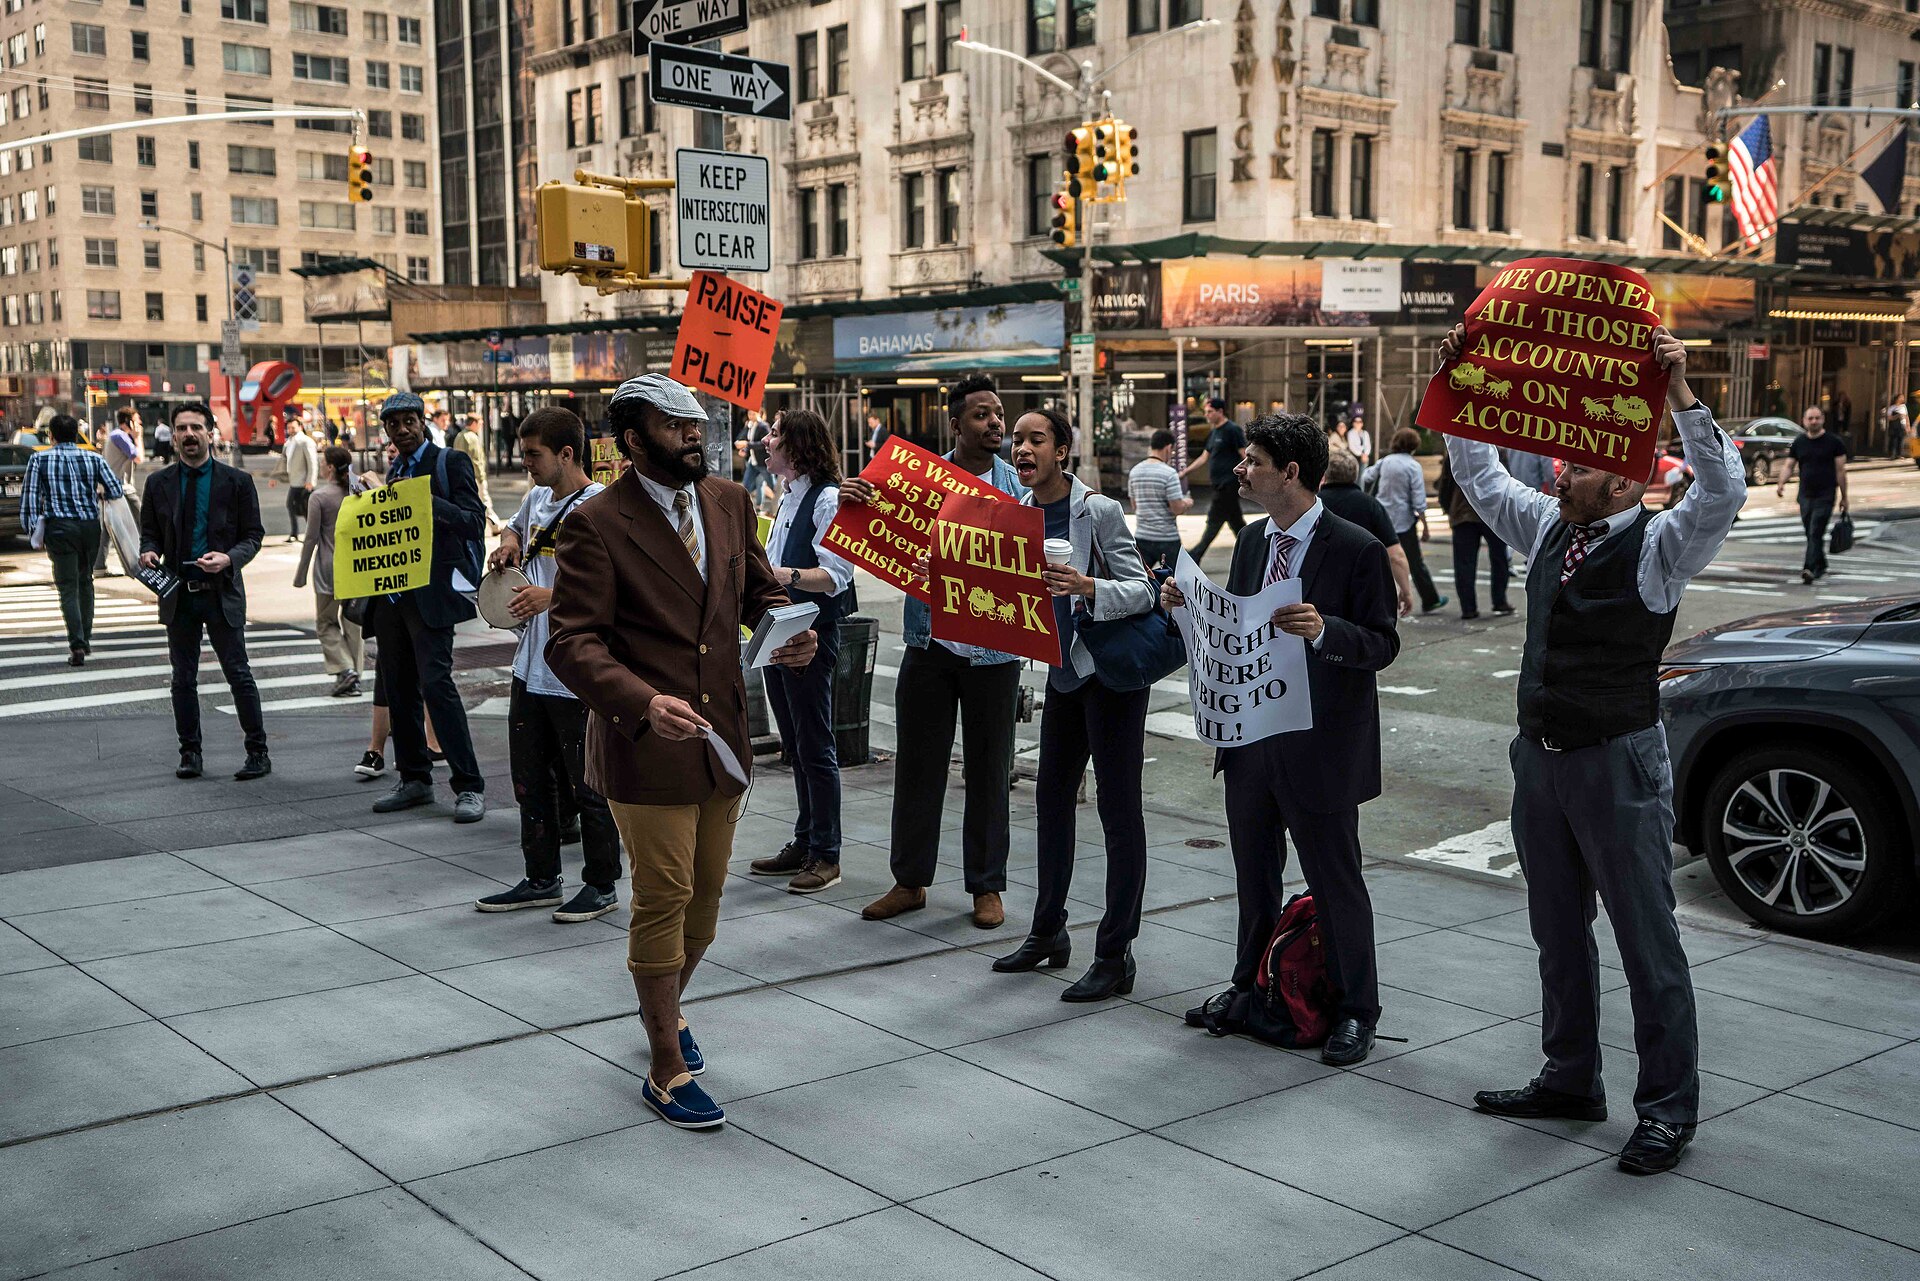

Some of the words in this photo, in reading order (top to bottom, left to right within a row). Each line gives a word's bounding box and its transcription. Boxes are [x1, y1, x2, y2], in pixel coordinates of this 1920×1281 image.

[651, 8, 682, 35] ONE
[697, 0, 729, 23] WAY
[672, 65, 712, 92] ONE
[730, 75, 770, 100] WAY
[700, 163, 747, 191] KEEP
[681, 198, 766, 225] INTERSECTION
[695, 232, 755, 259] CLEAR
[1199, 283, 1260, 304] PARIS
[1493, 268, 1535, 290] WE
[696, 274, 776, 334] RAISE
[1401, 291, 1455, 306] WARWICK
[1476, 297, 1533, 330] ALL
[1540, 306, 1653, 351] THOSE
[859, 333, 934, 355] BAHAMAS
[1469, 333, 1640, 387] ACCOUNTS
[511, 353, 549, 369] ONDON
[681, 343, 757, 400] PLOW
[1522, 379, 1571, 411] ON
[1451, 400, 1631, 462] ACCIDENT!
[890, 444, 922, 471] We
[924, 460, 981, 497] Want
[370, 487, 398, 505] 19%
[886, 471, 923, 503] $15
[357, 513, 376, 529] TO
[380, 505, 413, 525] SEND
[894, 502, 935, 538] Dol
[352, 530, 403, 551] MONEY
[405, 526, 420, 542] TO
[937, 519, 1042, 580] WELL
[353, 551, 408, 573] MEXICO
[410, 548, 422, 564] IS
[826, 523, 918, 587] Industry
[374, 573, 409, 592] FAIR!
[1193, 575, 1239, 625] WTF!
[1201, 651, 1273, 685] WERE
[1199, 679, 1243, 715] BIG
[1248, 678, 1288, 709] TO
